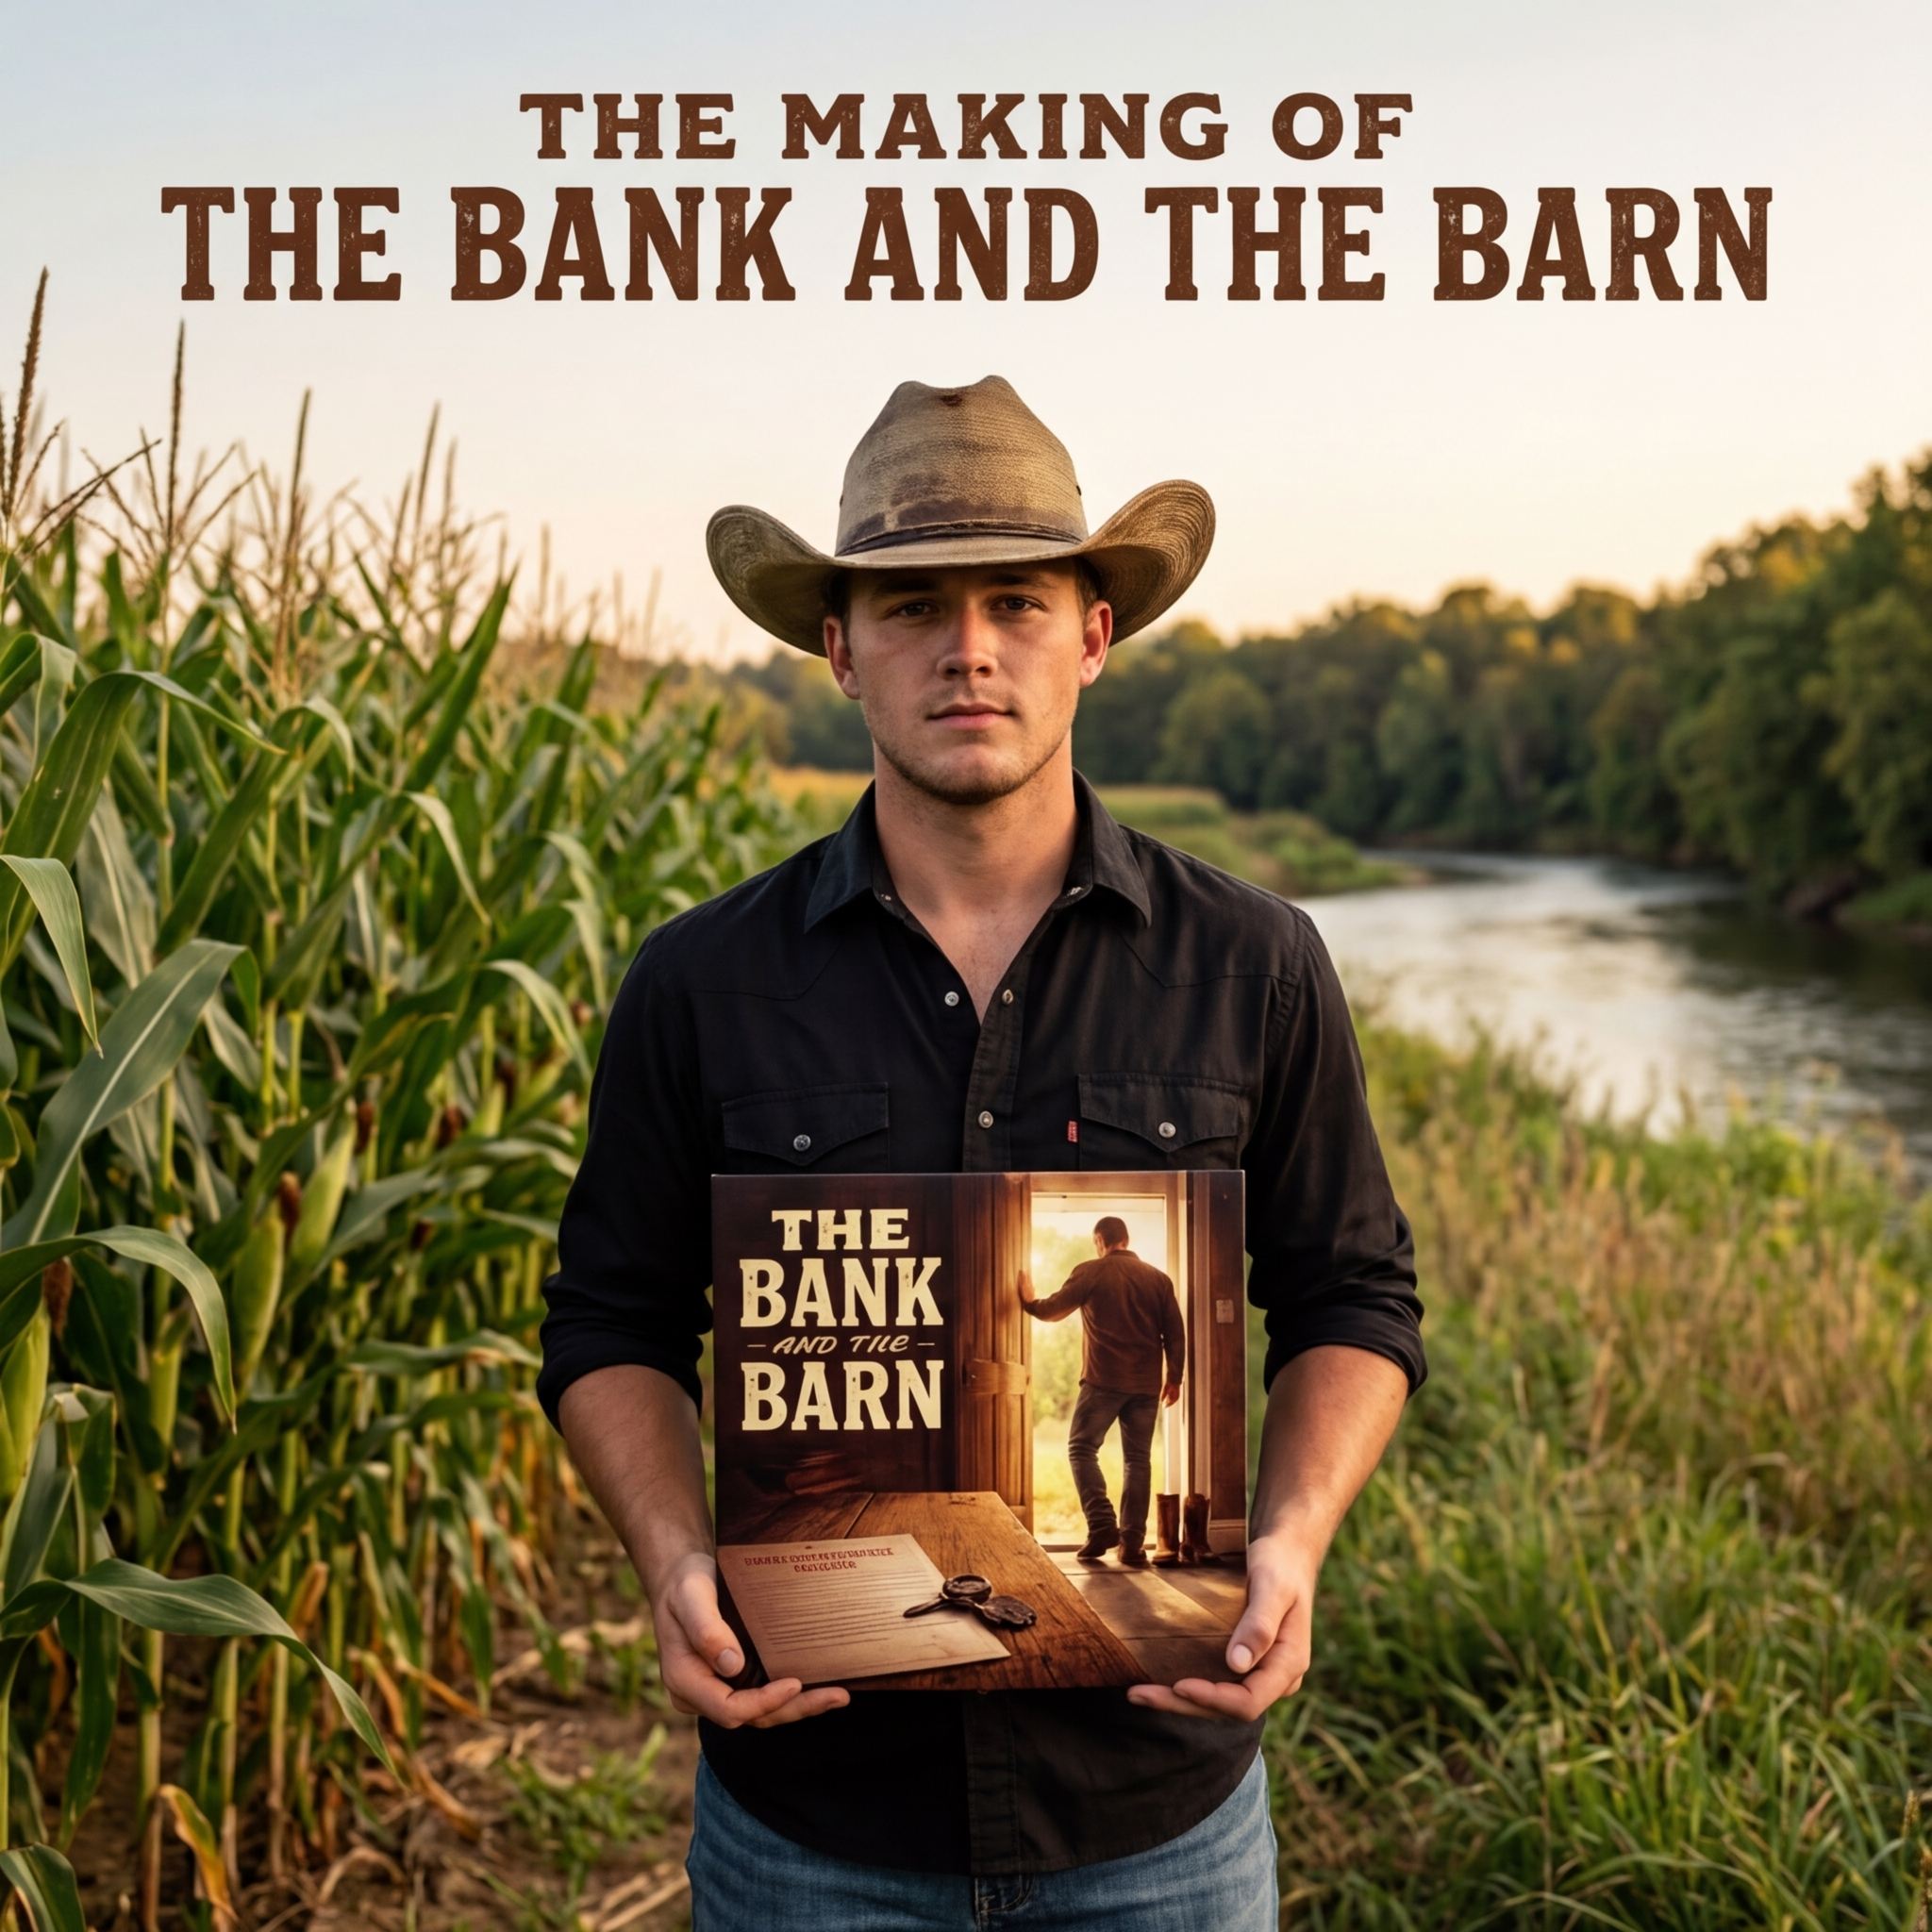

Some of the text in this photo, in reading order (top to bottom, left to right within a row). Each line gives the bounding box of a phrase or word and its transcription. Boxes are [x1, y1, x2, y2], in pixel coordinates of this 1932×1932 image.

[772, 1208, 910, 1252] THE
[740, 1257, 944, 1328] BANK
[772, 1336, 838, 1355] AND
[741, 1360, 944, 1432] BARN
